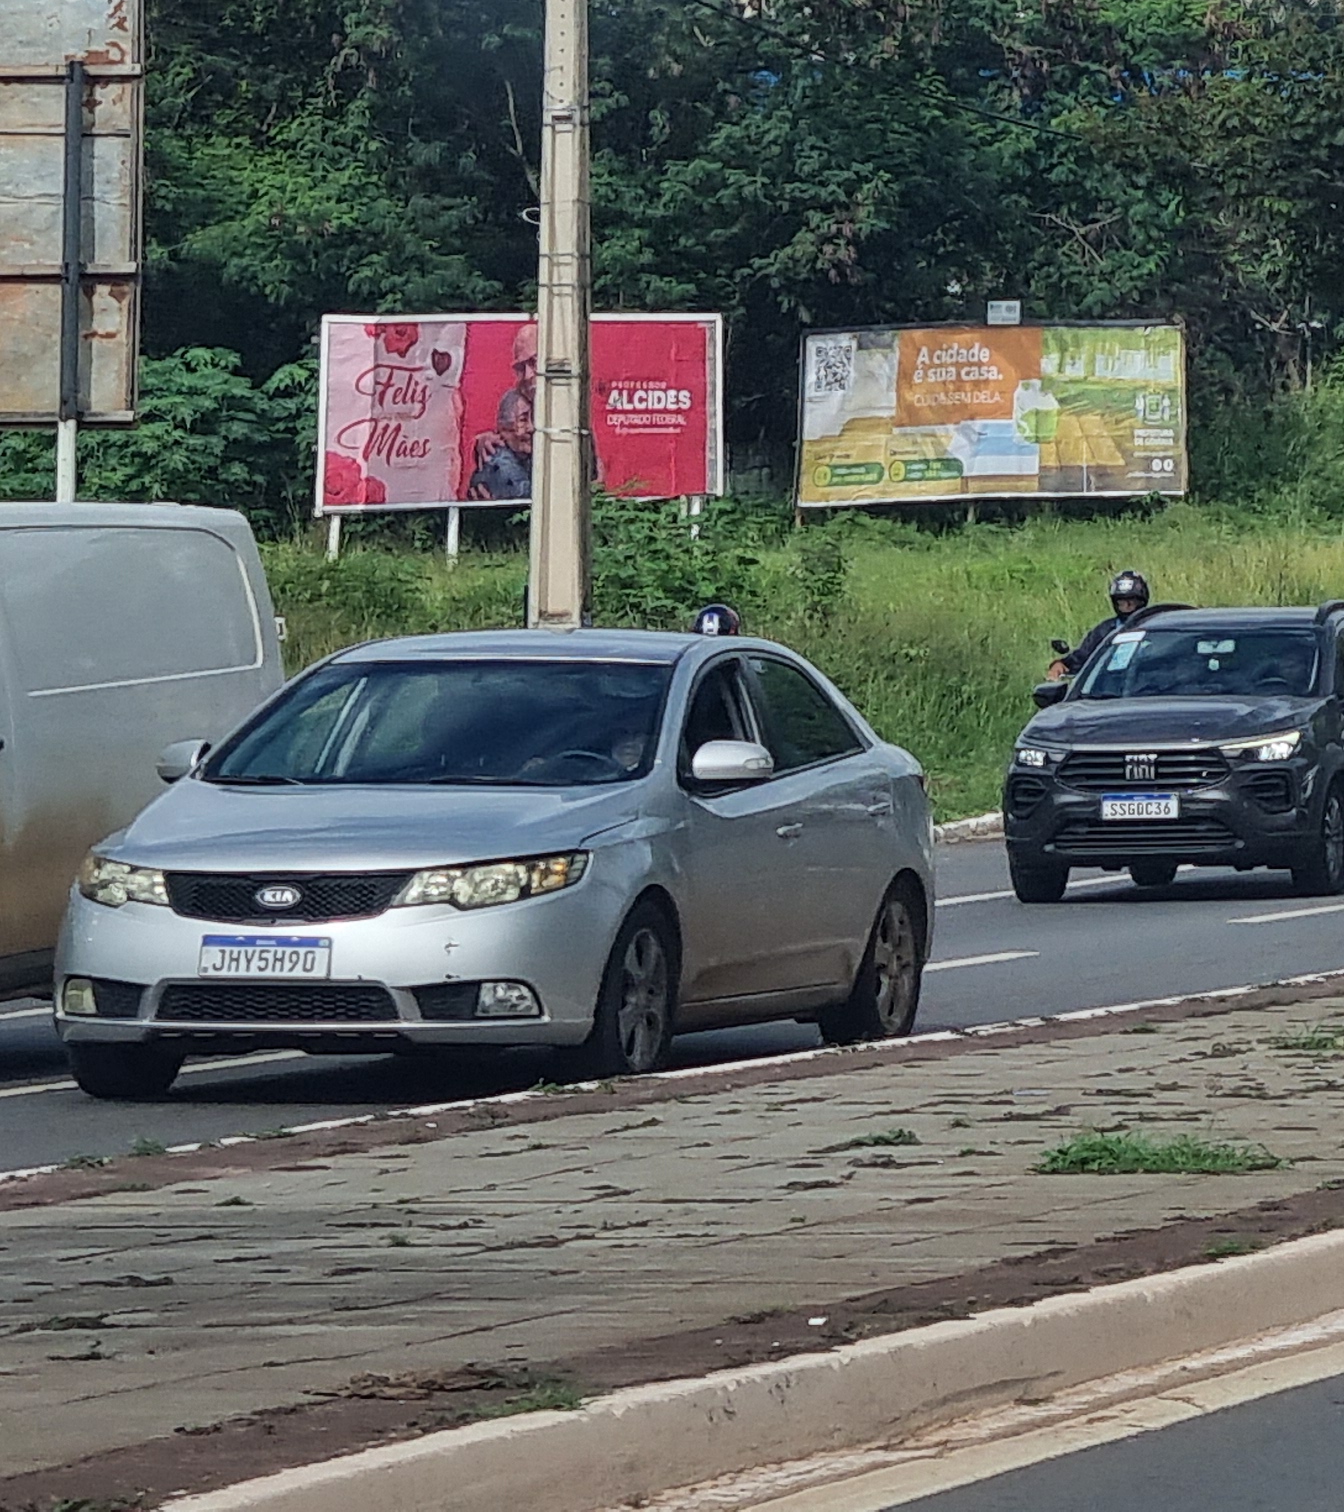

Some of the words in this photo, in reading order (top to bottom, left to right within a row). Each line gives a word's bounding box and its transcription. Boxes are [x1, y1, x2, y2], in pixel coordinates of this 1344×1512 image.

[916, 346, 930, 365] A
[932, 342, 990, 365] cidade
[913, 365, 924, 383] é
[927, 365, 957, 383] sua
[960, 364, 1004, 381] casa.
[355, 363, 433, 420] Feliz
[605, 389, 692, 410] ALCIDES
[1124, 753, 1158, 780] FIAT
[262, 890, 294, 903] KIA
[212, 948, 317, 974] JHY5H90
